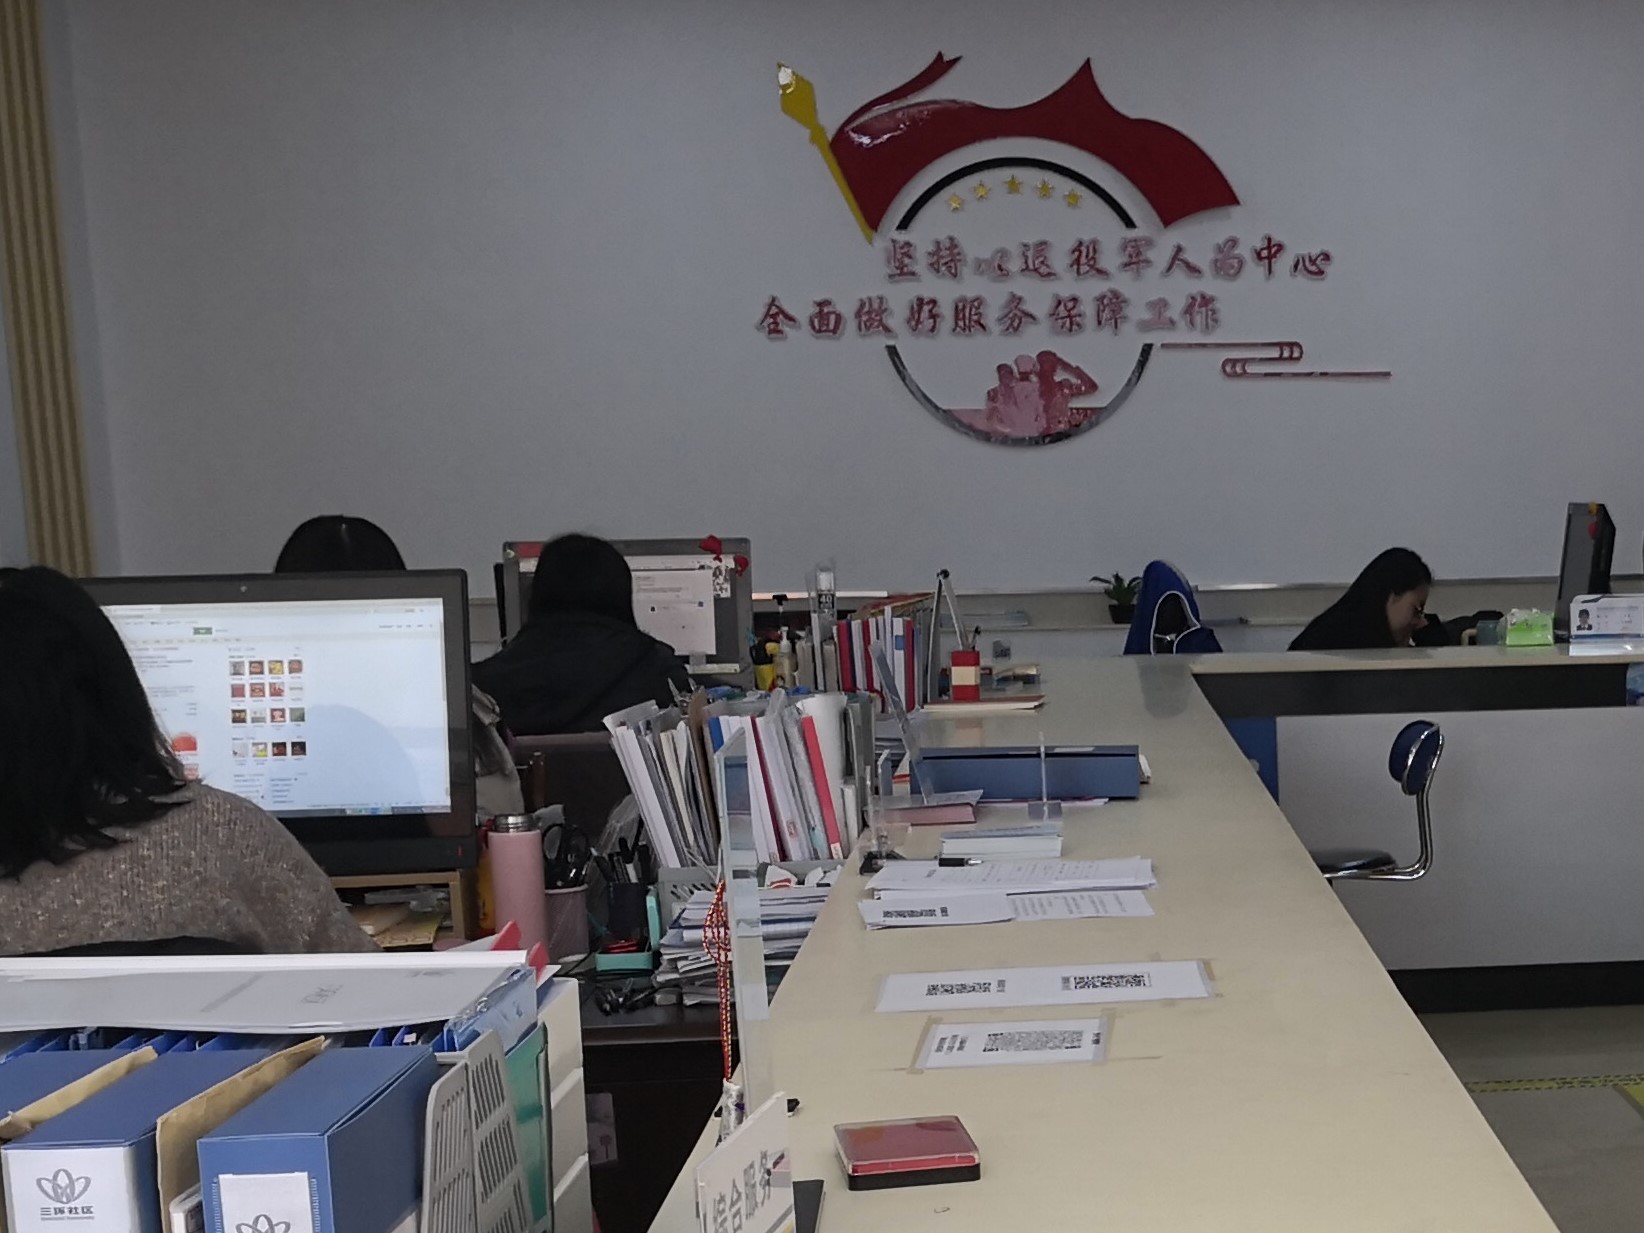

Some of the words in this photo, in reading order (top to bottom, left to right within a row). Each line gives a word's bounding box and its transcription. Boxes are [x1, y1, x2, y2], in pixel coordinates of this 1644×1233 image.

[756, 290, 1222, 338] 全面做好服务保障工作
